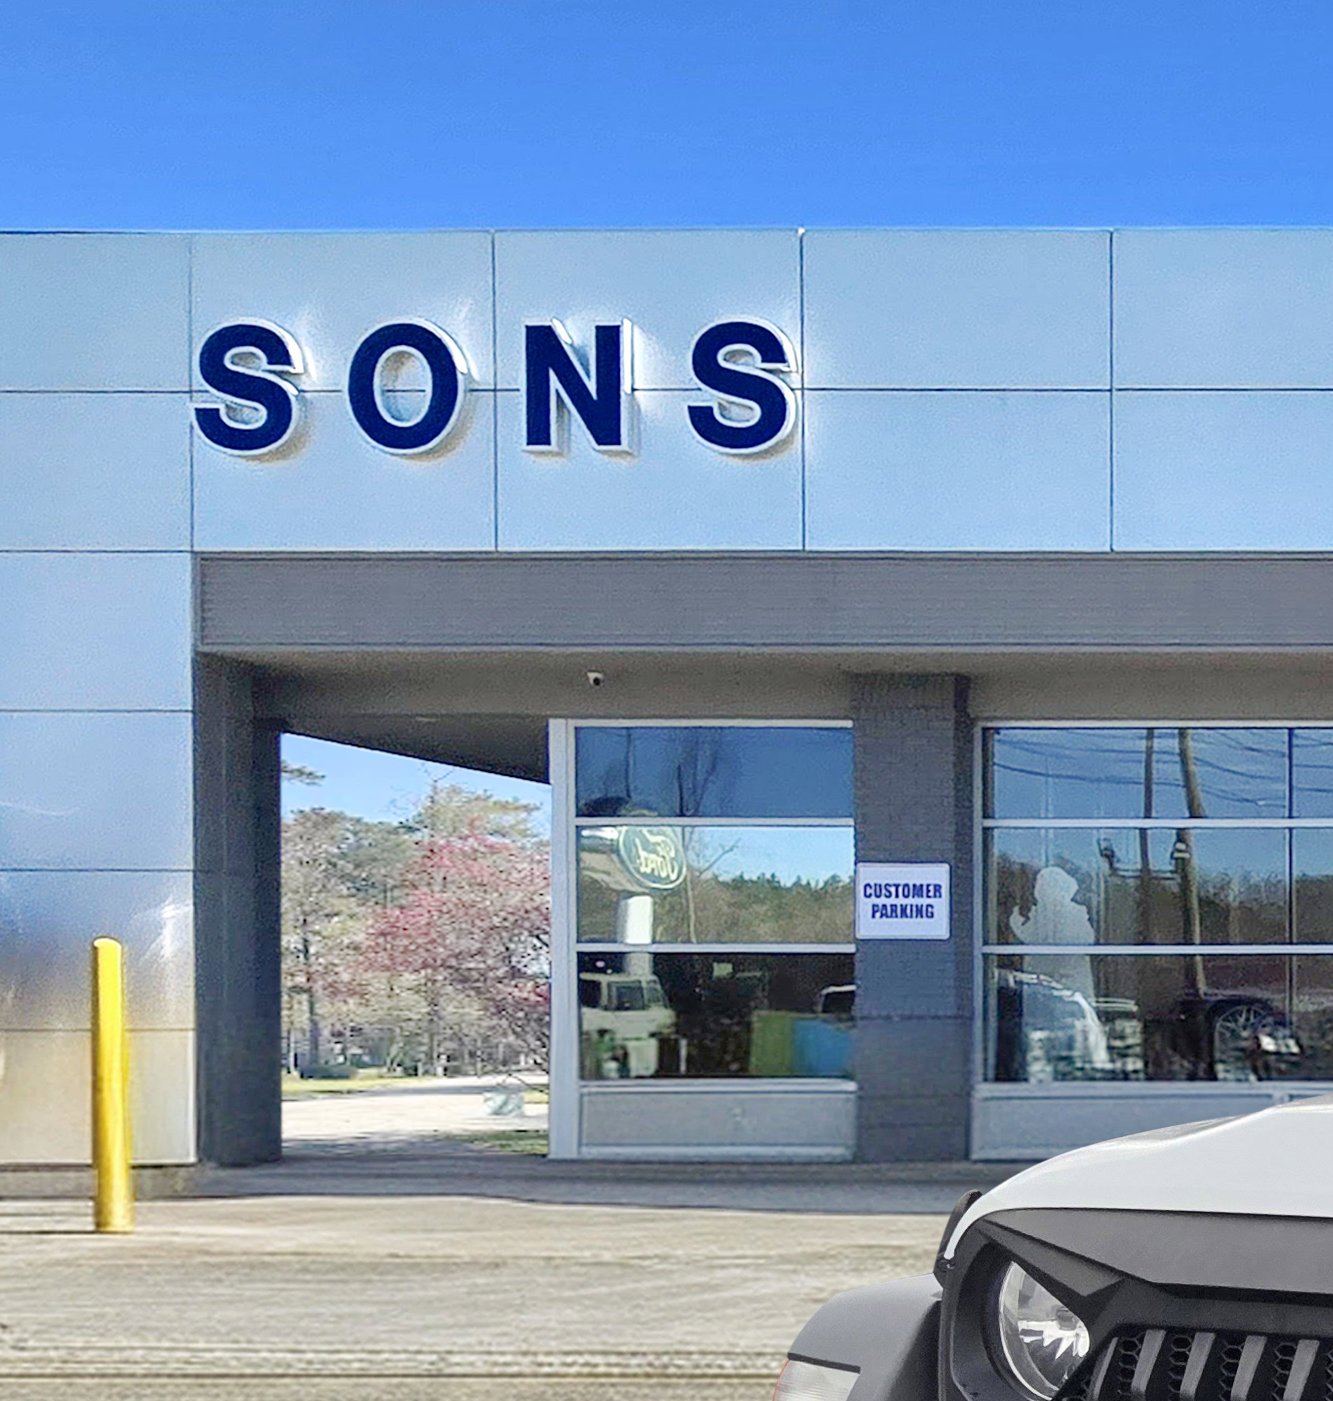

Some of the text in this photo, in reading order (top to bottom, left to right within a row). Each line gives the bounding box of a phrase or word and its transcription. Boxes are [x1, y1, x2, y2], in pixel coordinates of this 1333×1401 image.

[194, 321, 790, 452] SONS
[863, 883, 943, 899] CUSTOMER
[871, 903, 935, 919] PARKING
